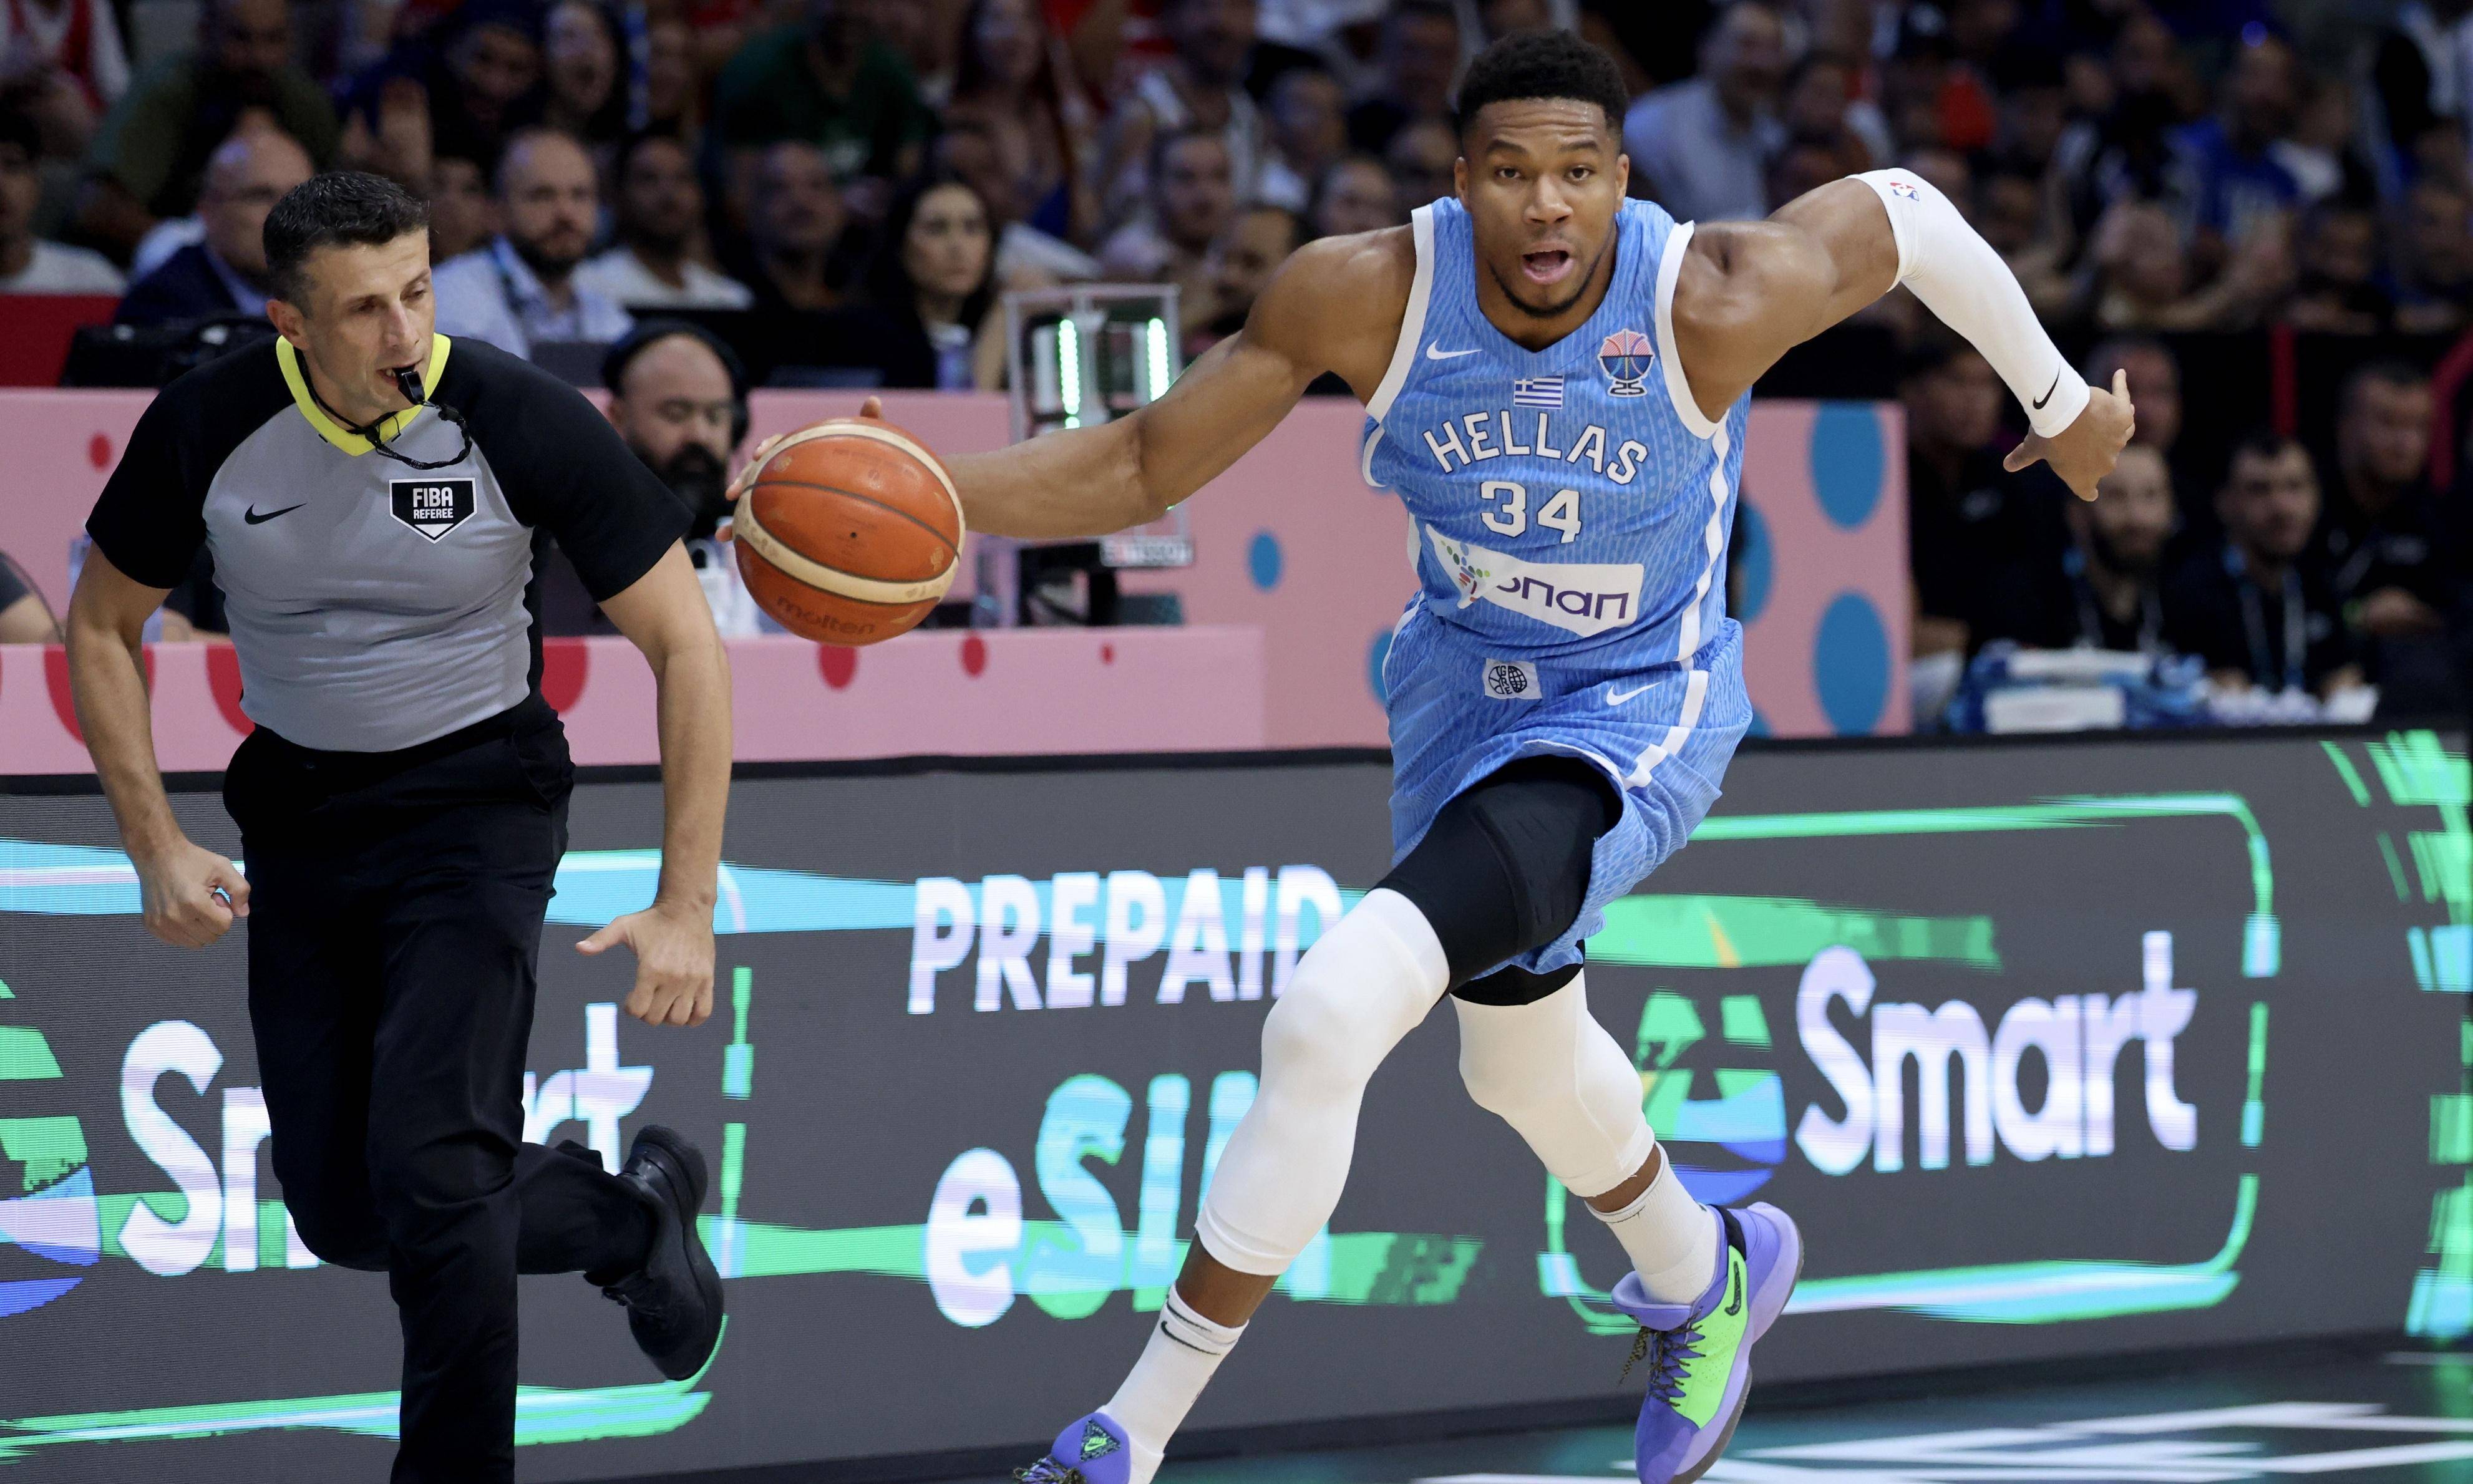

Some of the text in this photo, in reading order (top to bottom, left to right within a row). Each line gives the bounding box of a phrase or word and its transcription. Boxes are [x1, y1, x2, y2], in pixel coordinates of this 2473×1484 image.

[1422, 410, 1649, 485] HELLAS
[412, 487, 453, 508] FIBA
[413, 508, 454, 520] REFEREE
[1480, 480, 1582, 544] 34
[777, 596, 875, 635] molten
[908, 864, 1343, 1014] PREPAID
[1795, 930, 2197, 1175] Smart
